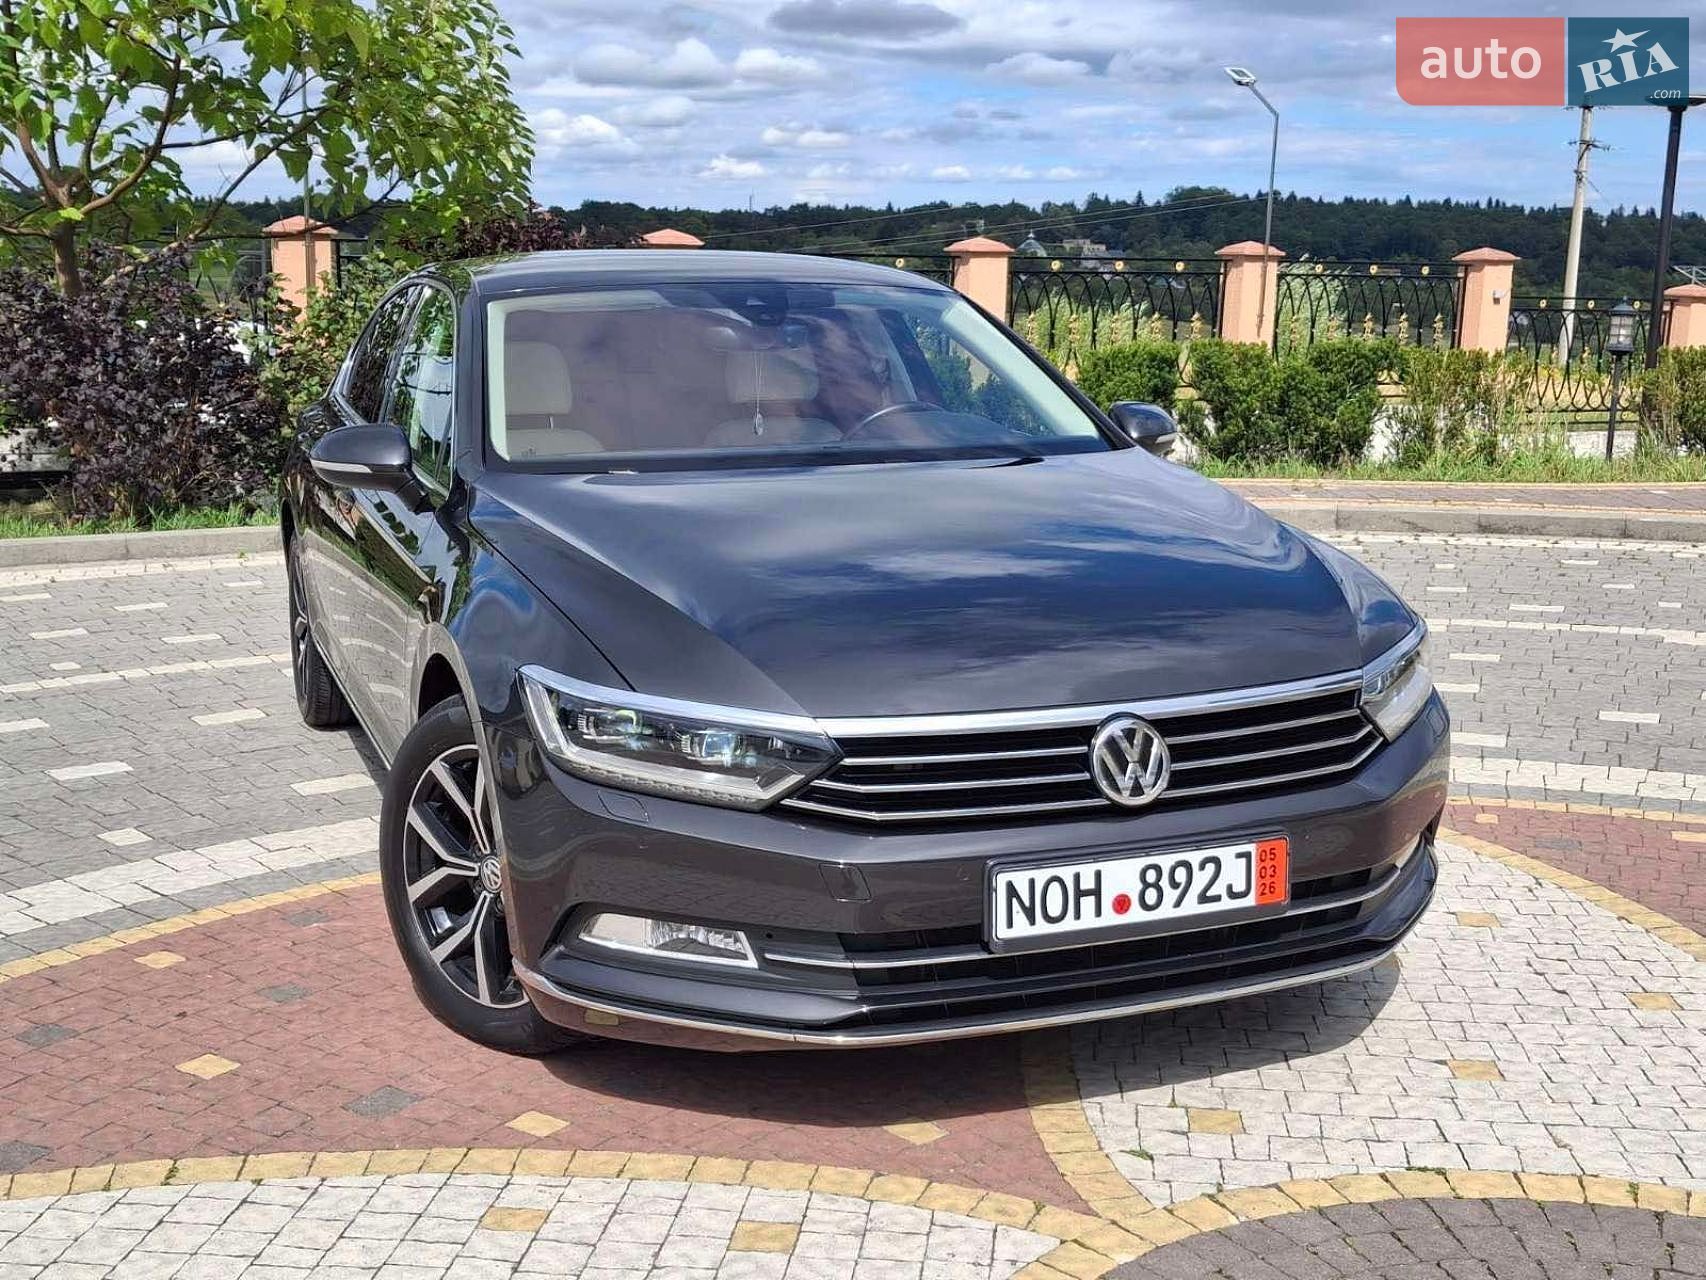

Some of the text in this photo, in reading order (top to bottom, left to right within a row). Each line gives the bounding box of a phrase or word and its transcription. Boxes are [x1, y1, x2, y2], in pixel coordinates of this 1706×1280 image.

[1259, 847, 1276, 862] 05
[1259, 864, 1276, 879] 03
[1005, 850, 1253, 929] NOH 892J
[1259, 881, 1276, 896] 26
